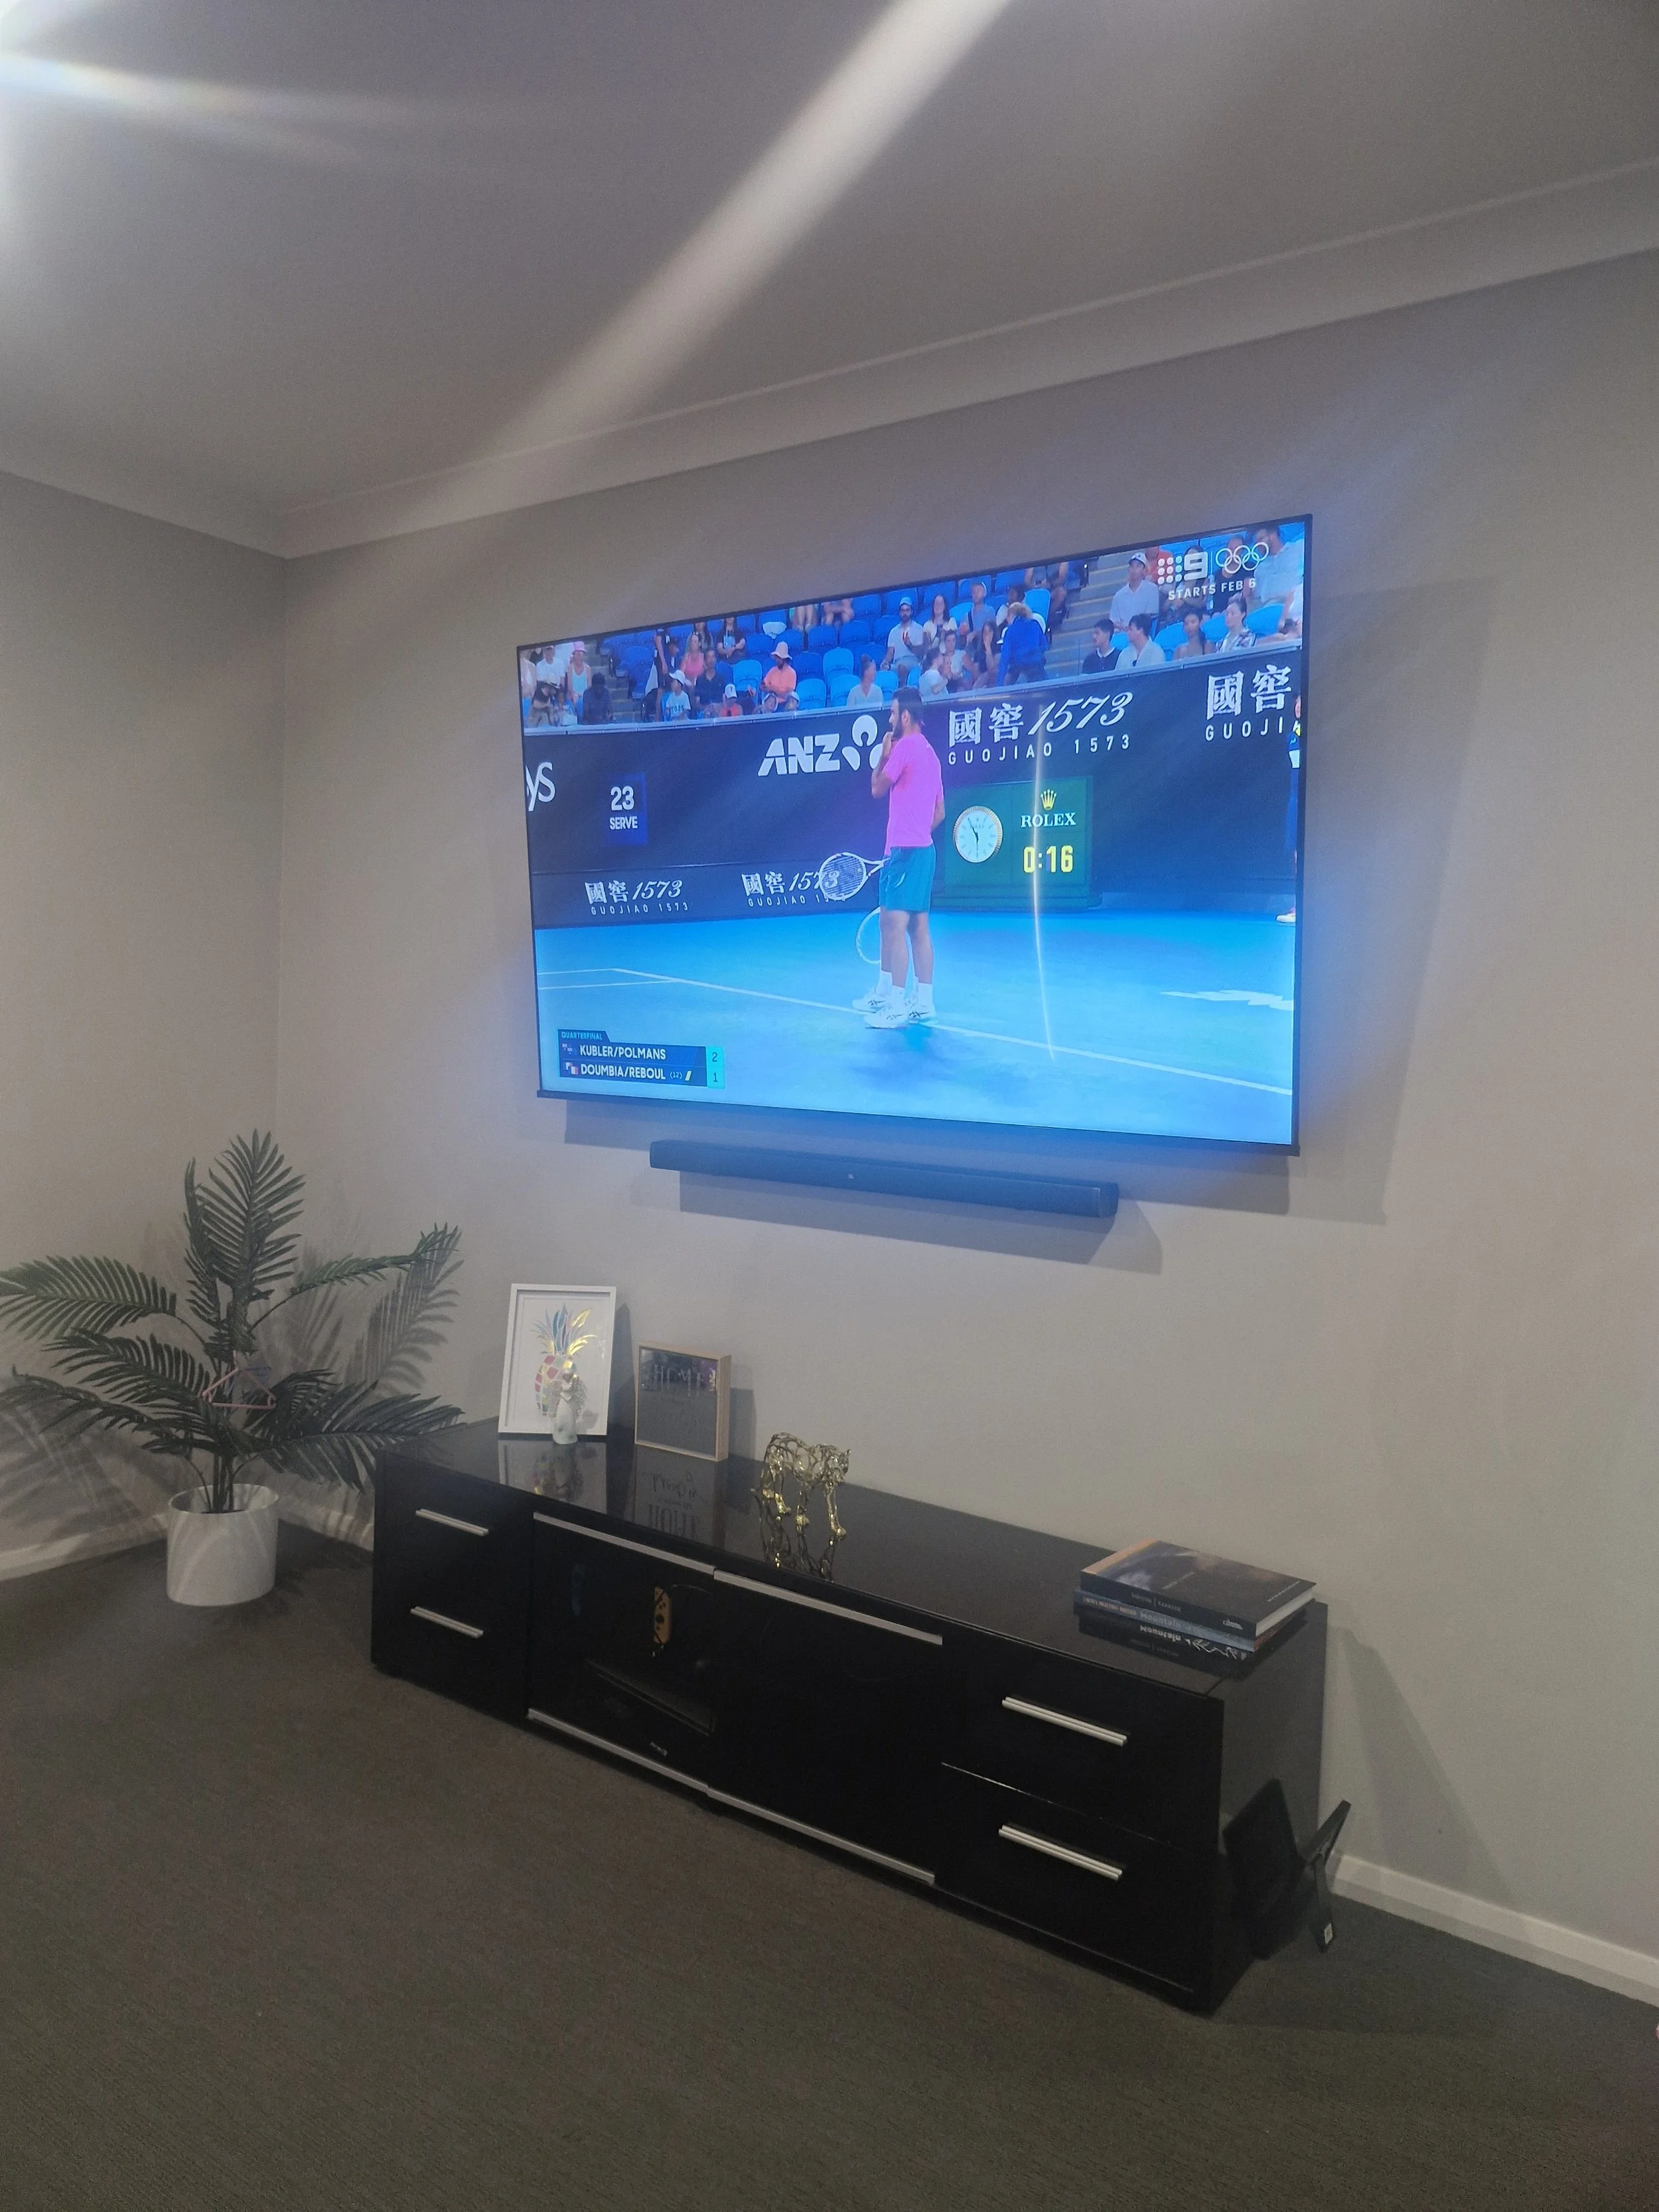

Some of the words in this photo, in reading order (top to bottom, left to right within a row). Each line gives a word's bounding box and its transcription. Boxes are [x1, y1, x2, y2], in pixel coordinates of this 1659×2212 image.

[1168, 583, 1216, 600] STARTS
[1221, 579, 1243, 593] FEB
[1249, 577, 1256, 588] 6
[758, 733, 840, 776] ANZ
[948, 742, 1052, 765] GUOJIAO
[1074, 734, 1129, 754] 1573
[526, 762, 555, 811] ys
[611, 786, 635, 811] 23
[609, 816, 638, 830] SERVE
[1021, 812, 1076, 828] ROLEX
[1023, 845, 1074, 873] 0:16
[591, 904, 648, 915] GUOJIAO
[658, 902, 688, 913] 1573
[748, 895, 806, 907] GUOJIAO
[561, 1031, 603, 1041] QUARTERFINAL
[580, 1044, 666, 1061] KUBLER/POLMANS
[711, 1052, 718, 1063] 2
[581, 1063, 666, 1080] DOUMBIA/REBOUL
[713, 1072, 718, 1082] 1
